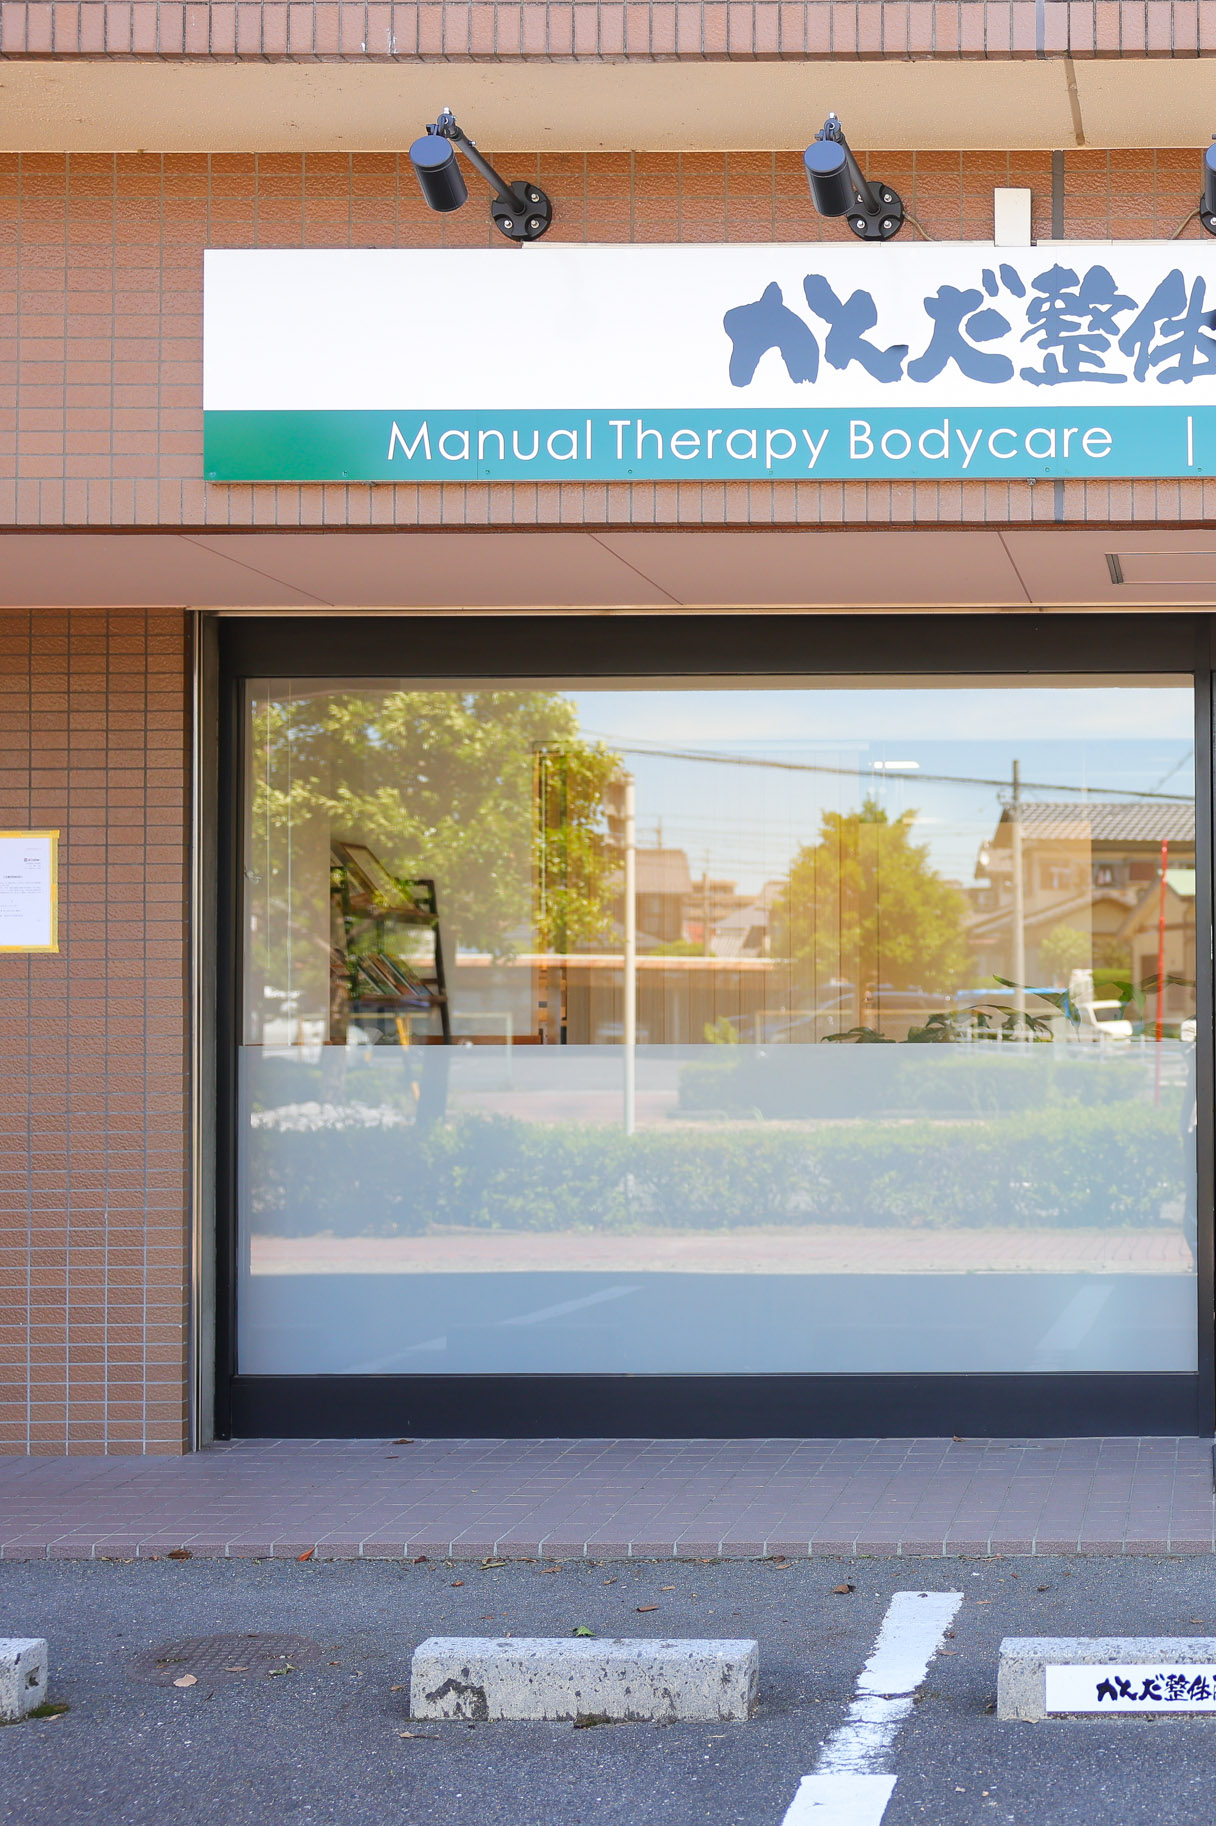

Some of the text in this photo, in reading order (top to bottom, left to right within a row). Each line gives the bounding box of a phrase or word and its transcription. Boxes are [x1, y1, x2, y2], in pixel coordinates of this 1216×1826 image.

[387, 419, 593, 462] Manual
[608, 419, 830, 470] Therapy
[849, 418, 1113, 469] Bodycare
